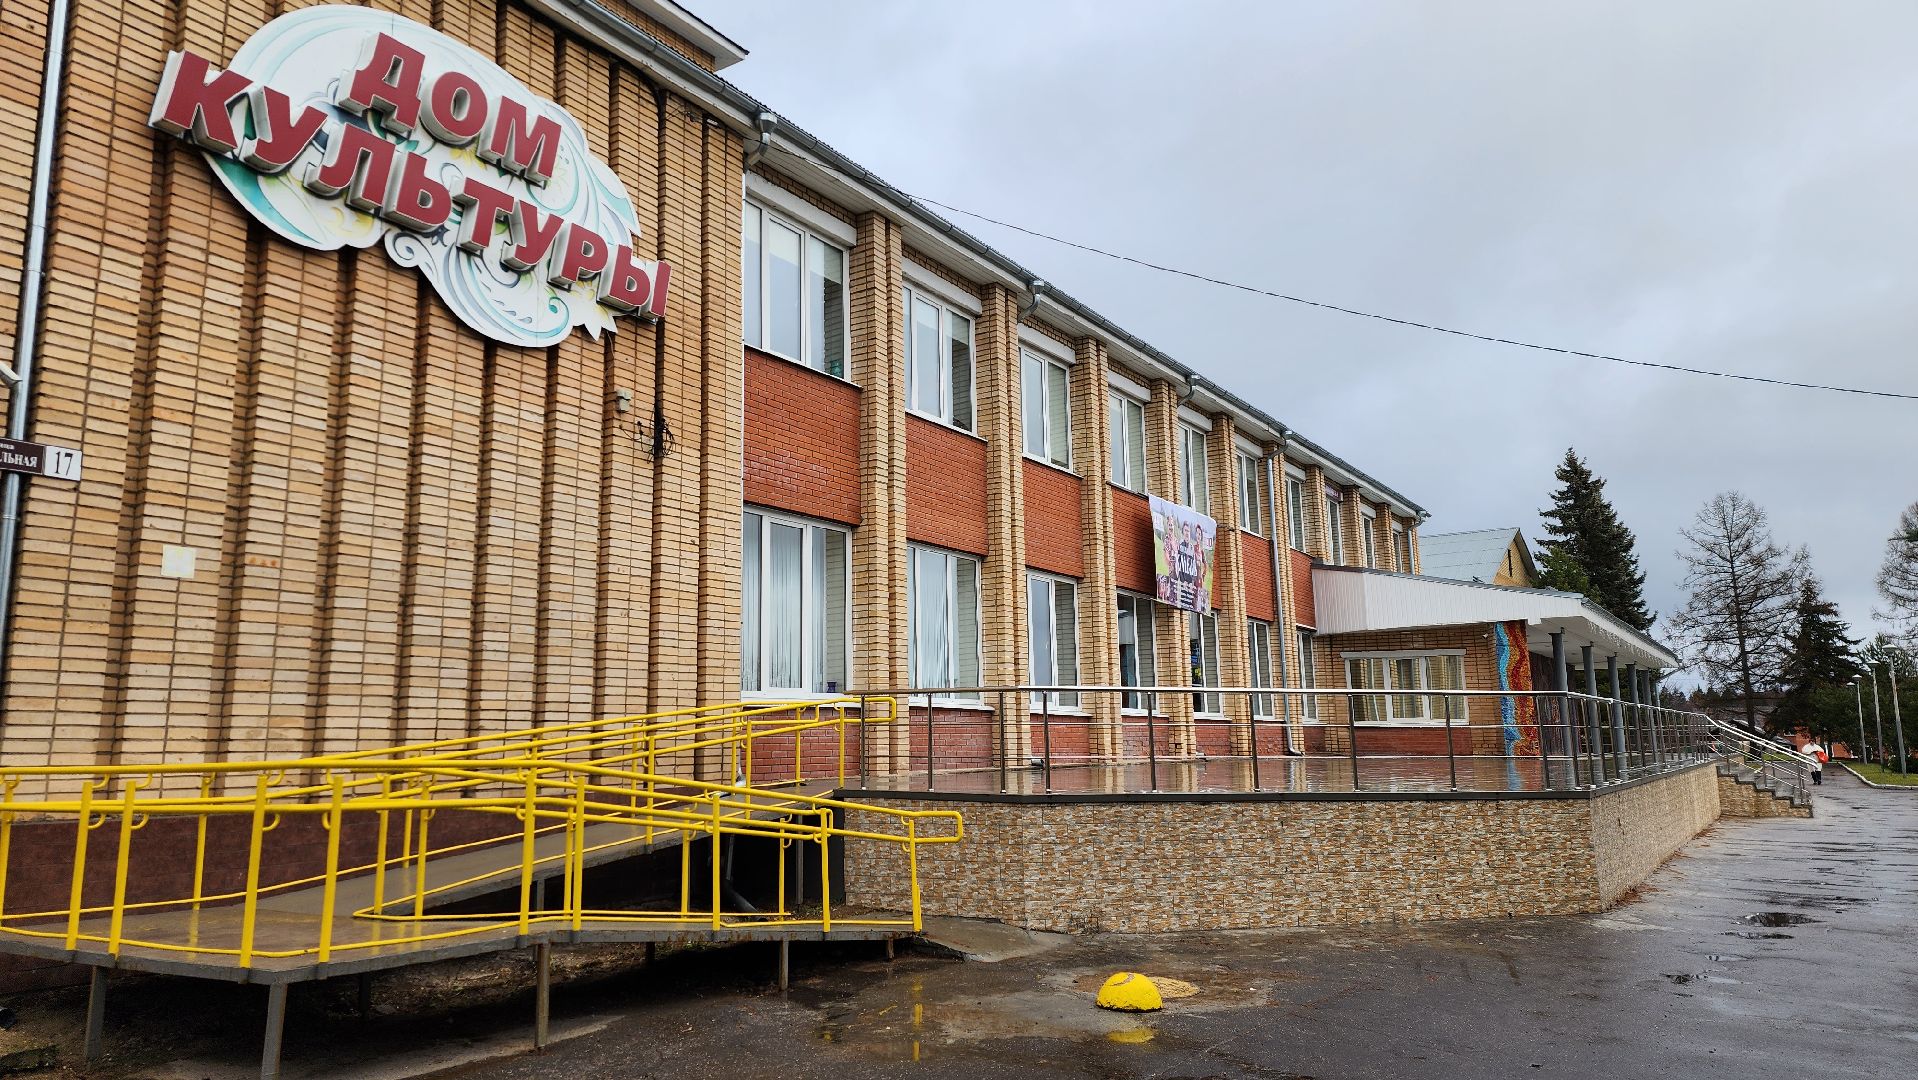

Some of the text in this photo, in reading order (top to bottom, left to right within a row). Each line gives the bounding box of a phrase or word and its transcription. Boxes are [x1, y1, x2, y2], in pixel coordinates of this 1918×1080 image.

[151, 50, 673, 322] КУЛЬТУРЫ
[342, 32, 562, 187] ДОМ
[55, 451, 73, 476] 17
